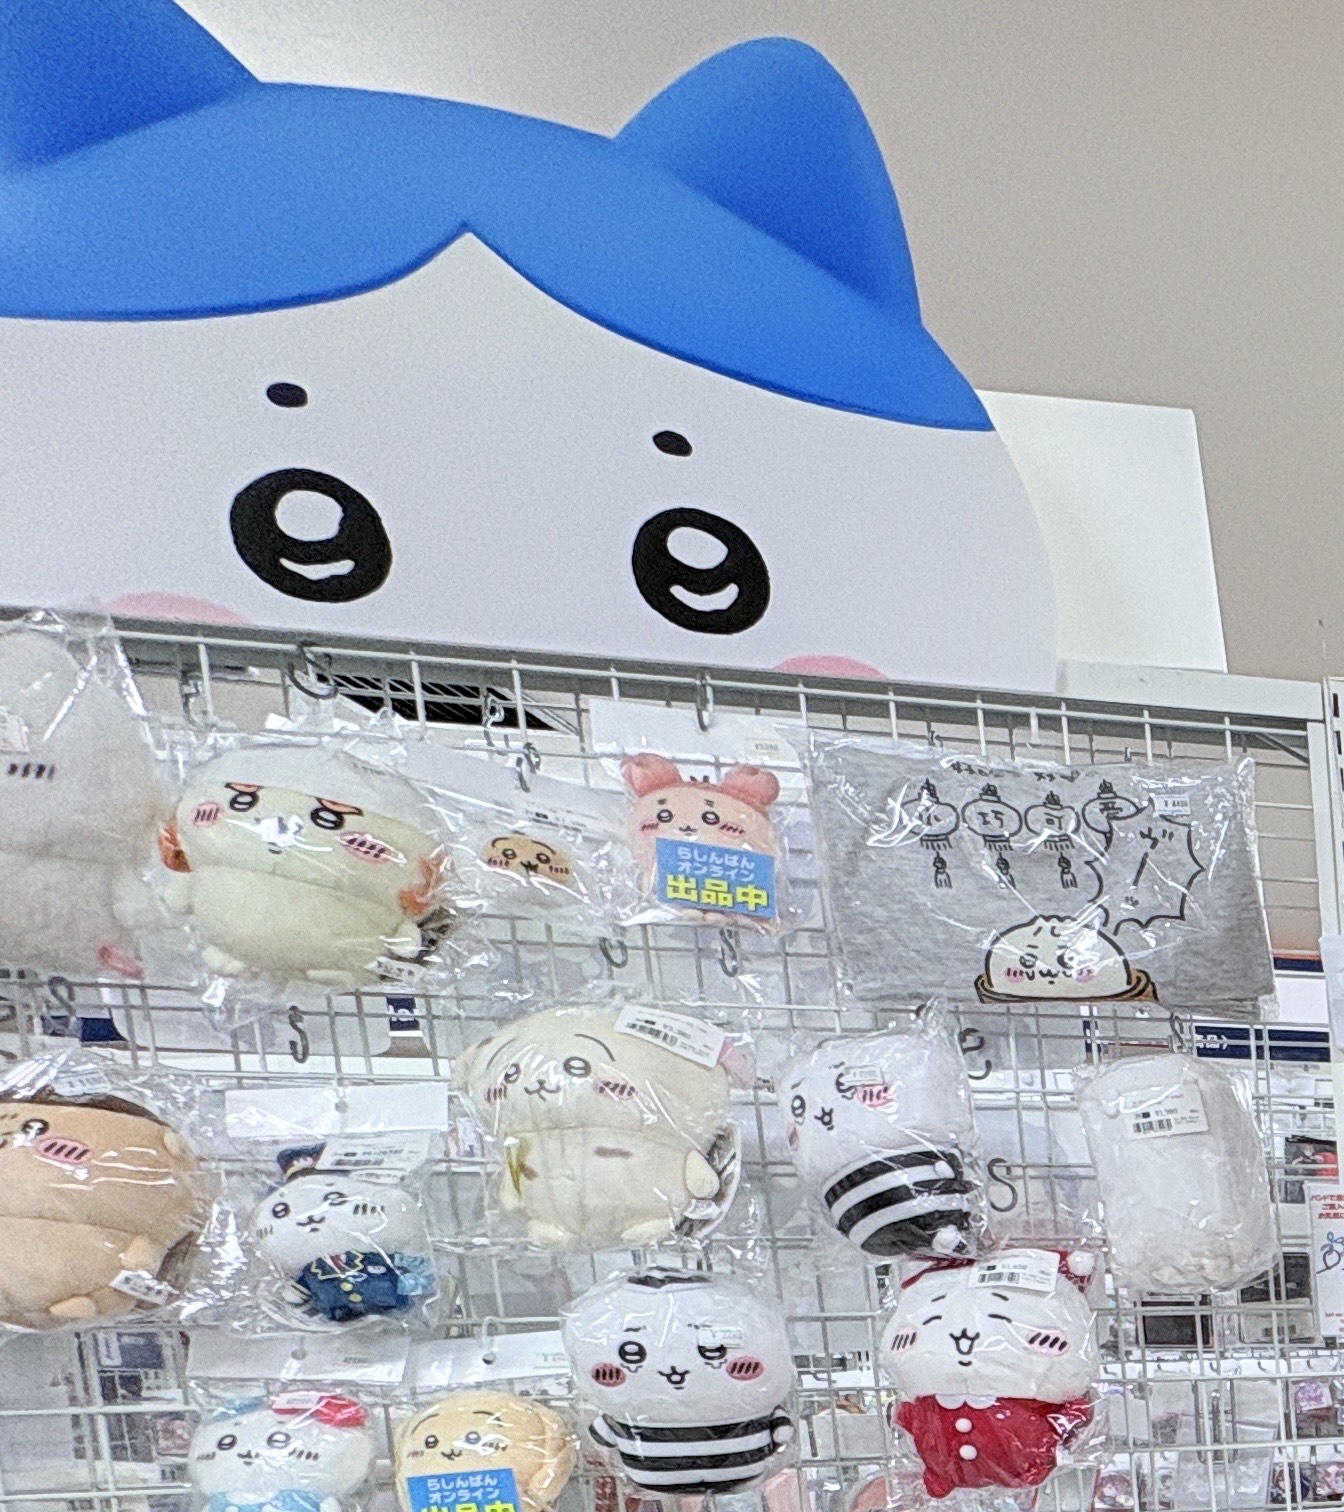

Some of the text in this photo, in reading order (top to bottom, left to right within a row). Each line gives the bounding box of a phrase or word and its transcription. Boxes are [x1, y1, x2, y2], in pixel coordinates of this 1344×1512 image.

[677, 846, 755, 870] らしんばん
[677, 861, 755, 882] オンライン
[666, 873, 768, 911] 出品中
[427, 1474, 498, 1491] らしんばん
[428, 1487, 500, 1503] オンライン
